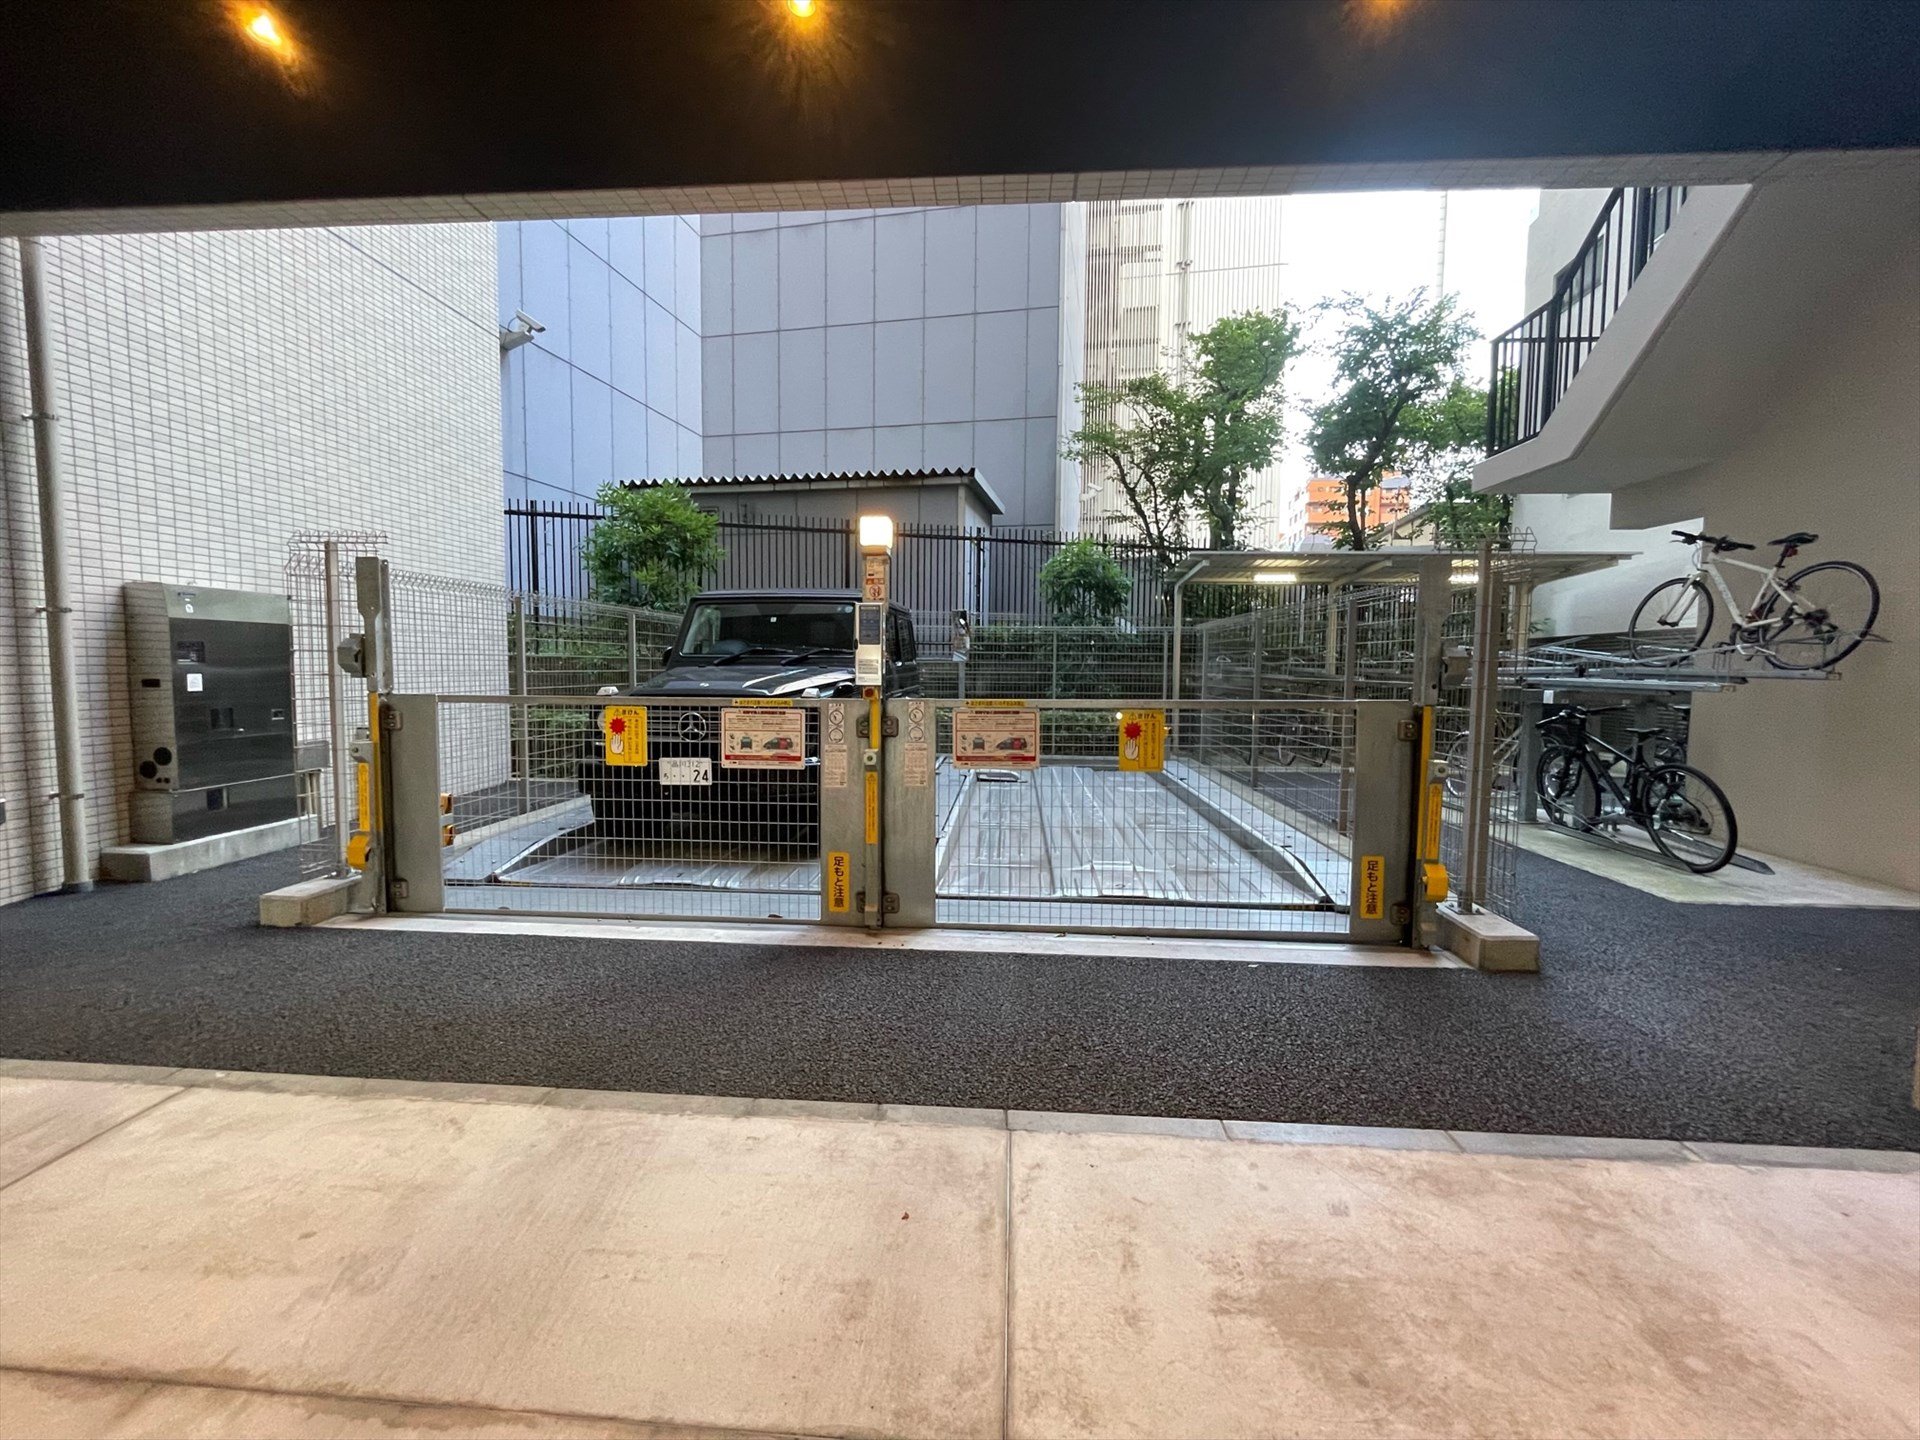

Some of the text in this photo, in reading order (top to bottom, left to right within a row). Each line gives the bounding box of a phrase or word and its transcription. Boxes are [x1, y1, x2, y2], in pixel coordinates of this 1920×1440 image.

[833, 856, 844, 908] 足もと注意
[1366, 860, 1378, 915] 足もと注意
